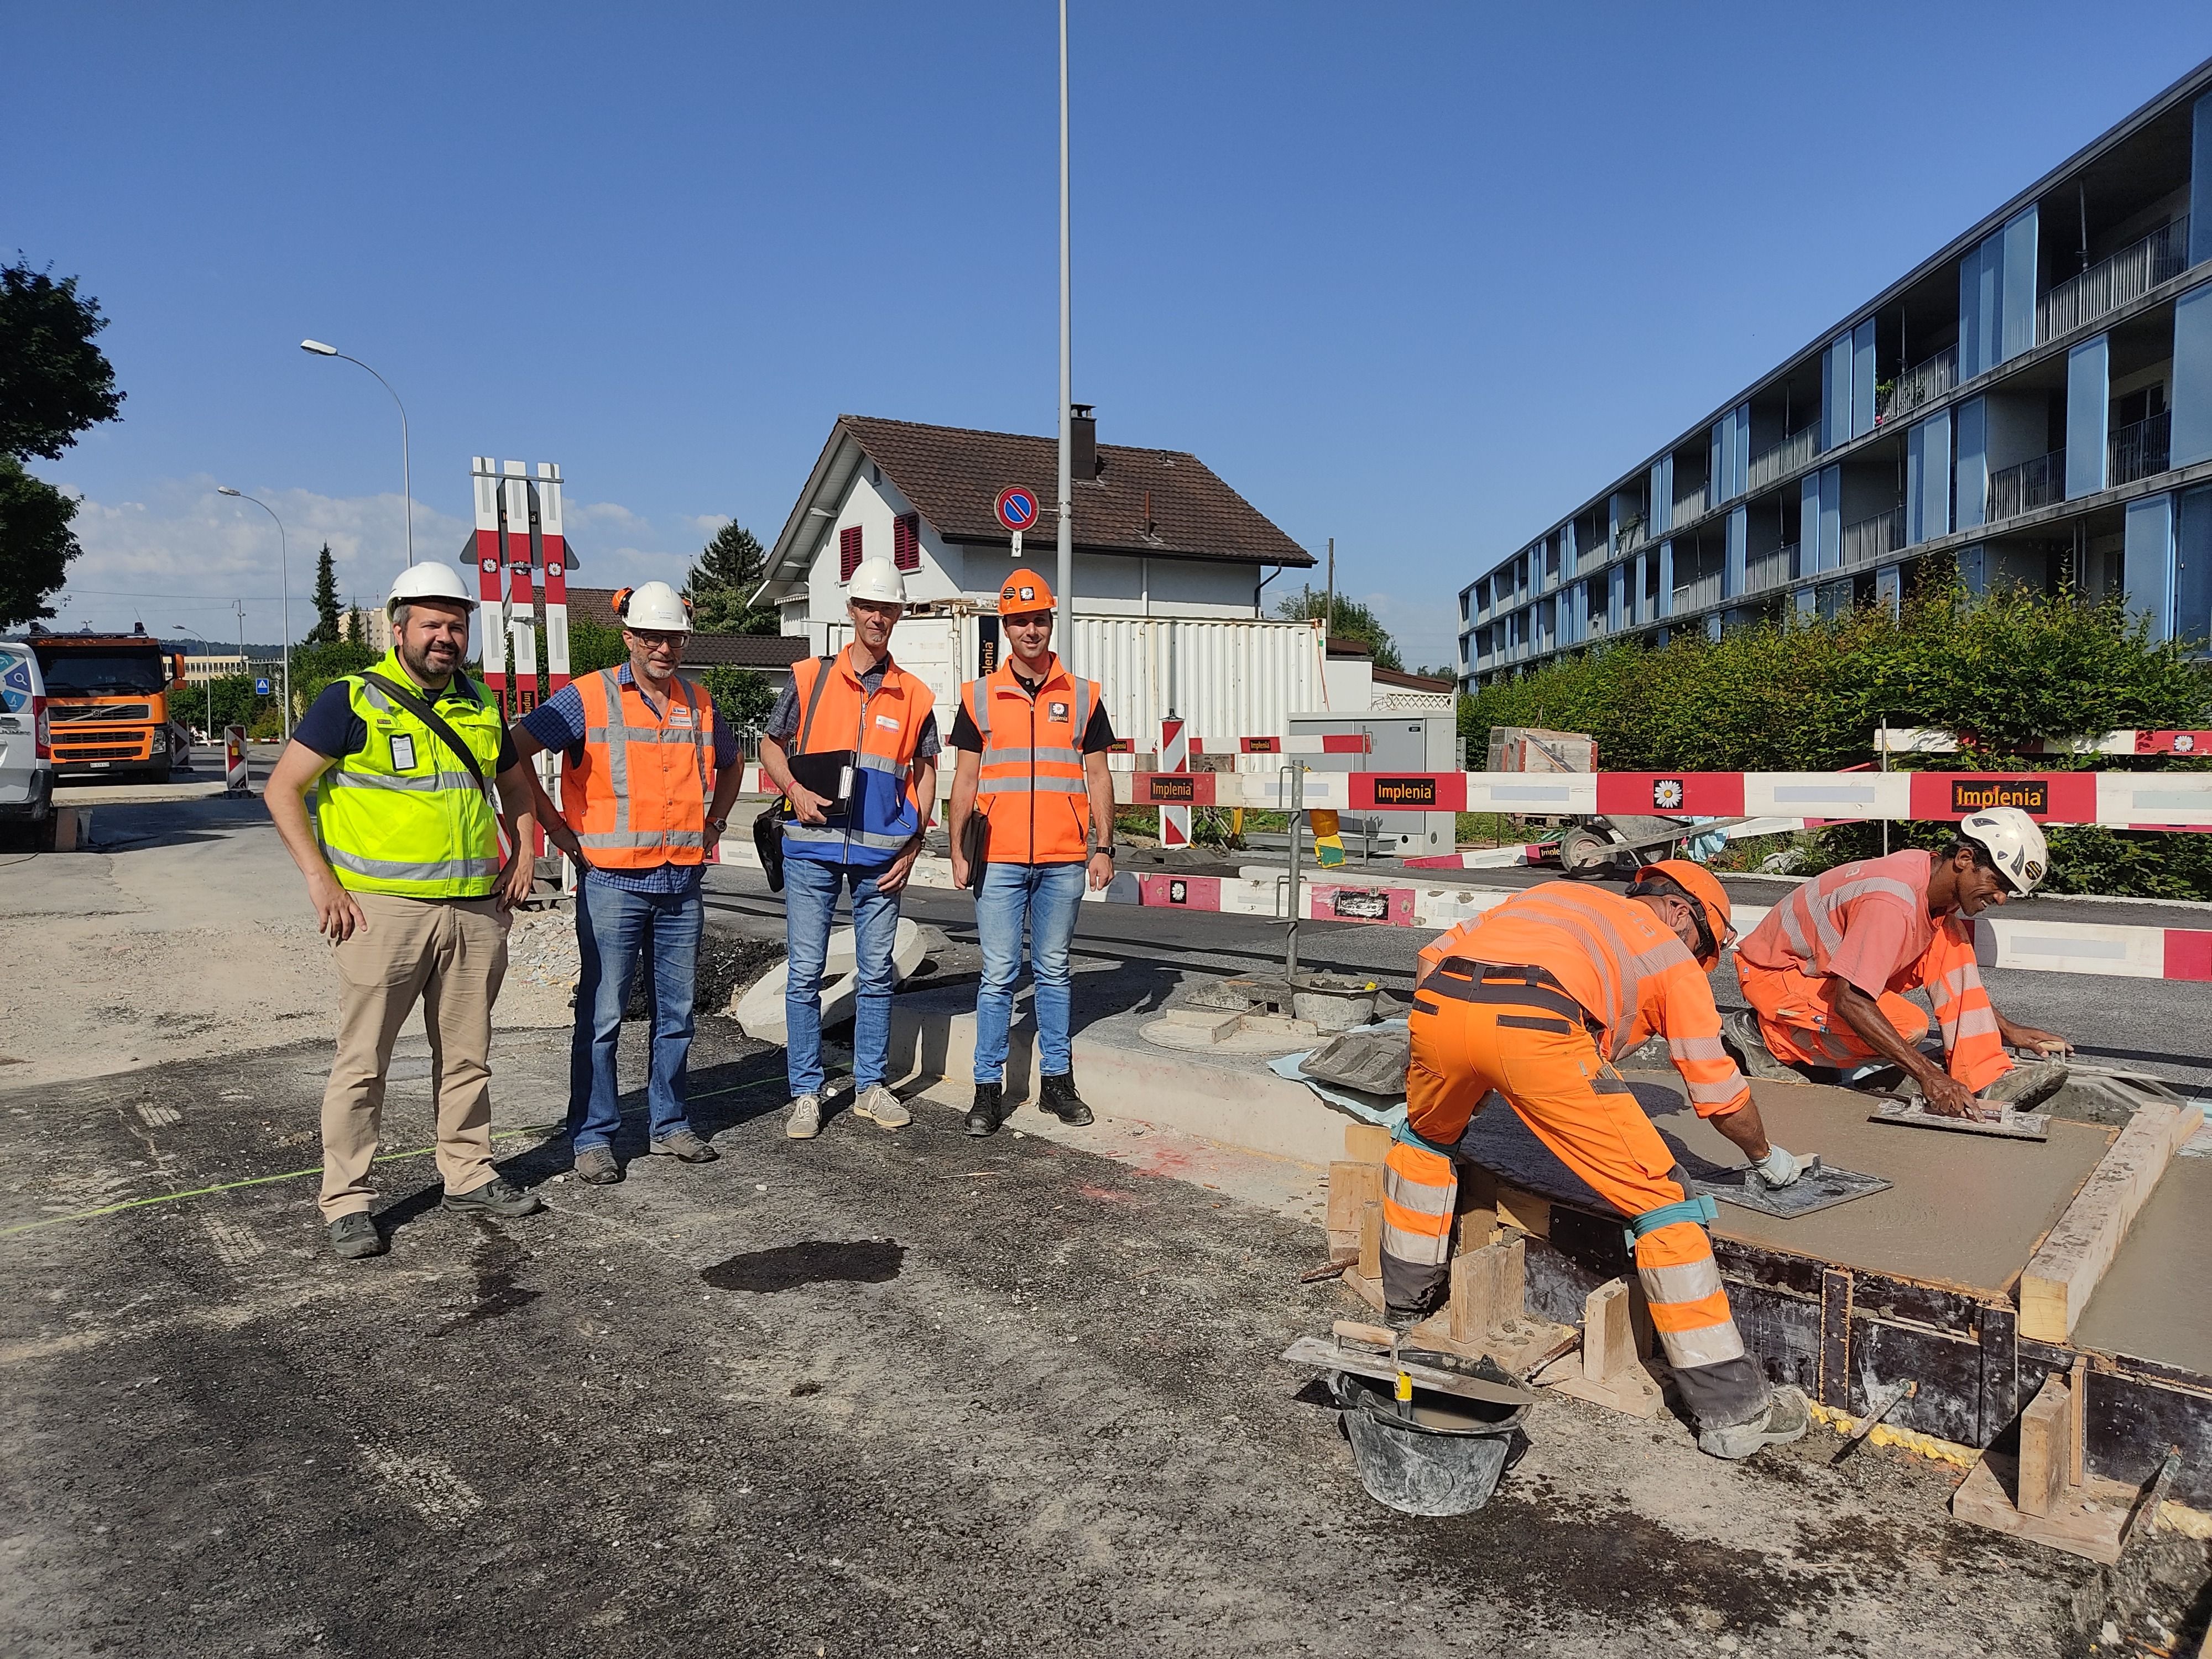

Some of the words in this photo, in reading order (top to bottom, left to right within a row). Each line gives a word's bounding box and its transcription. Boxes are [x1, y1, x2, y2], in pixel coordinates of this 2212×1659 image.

[982, 640, 994, 676] plenia
[523, 692, 533, 714] Imple
[1251, 740, 1270, 750] Implenia
[1152, 782, 1192, 799] Implenia
[1378, 783, 1433, 803] Implenia
[1541, 847, 1561, 857] Imple
